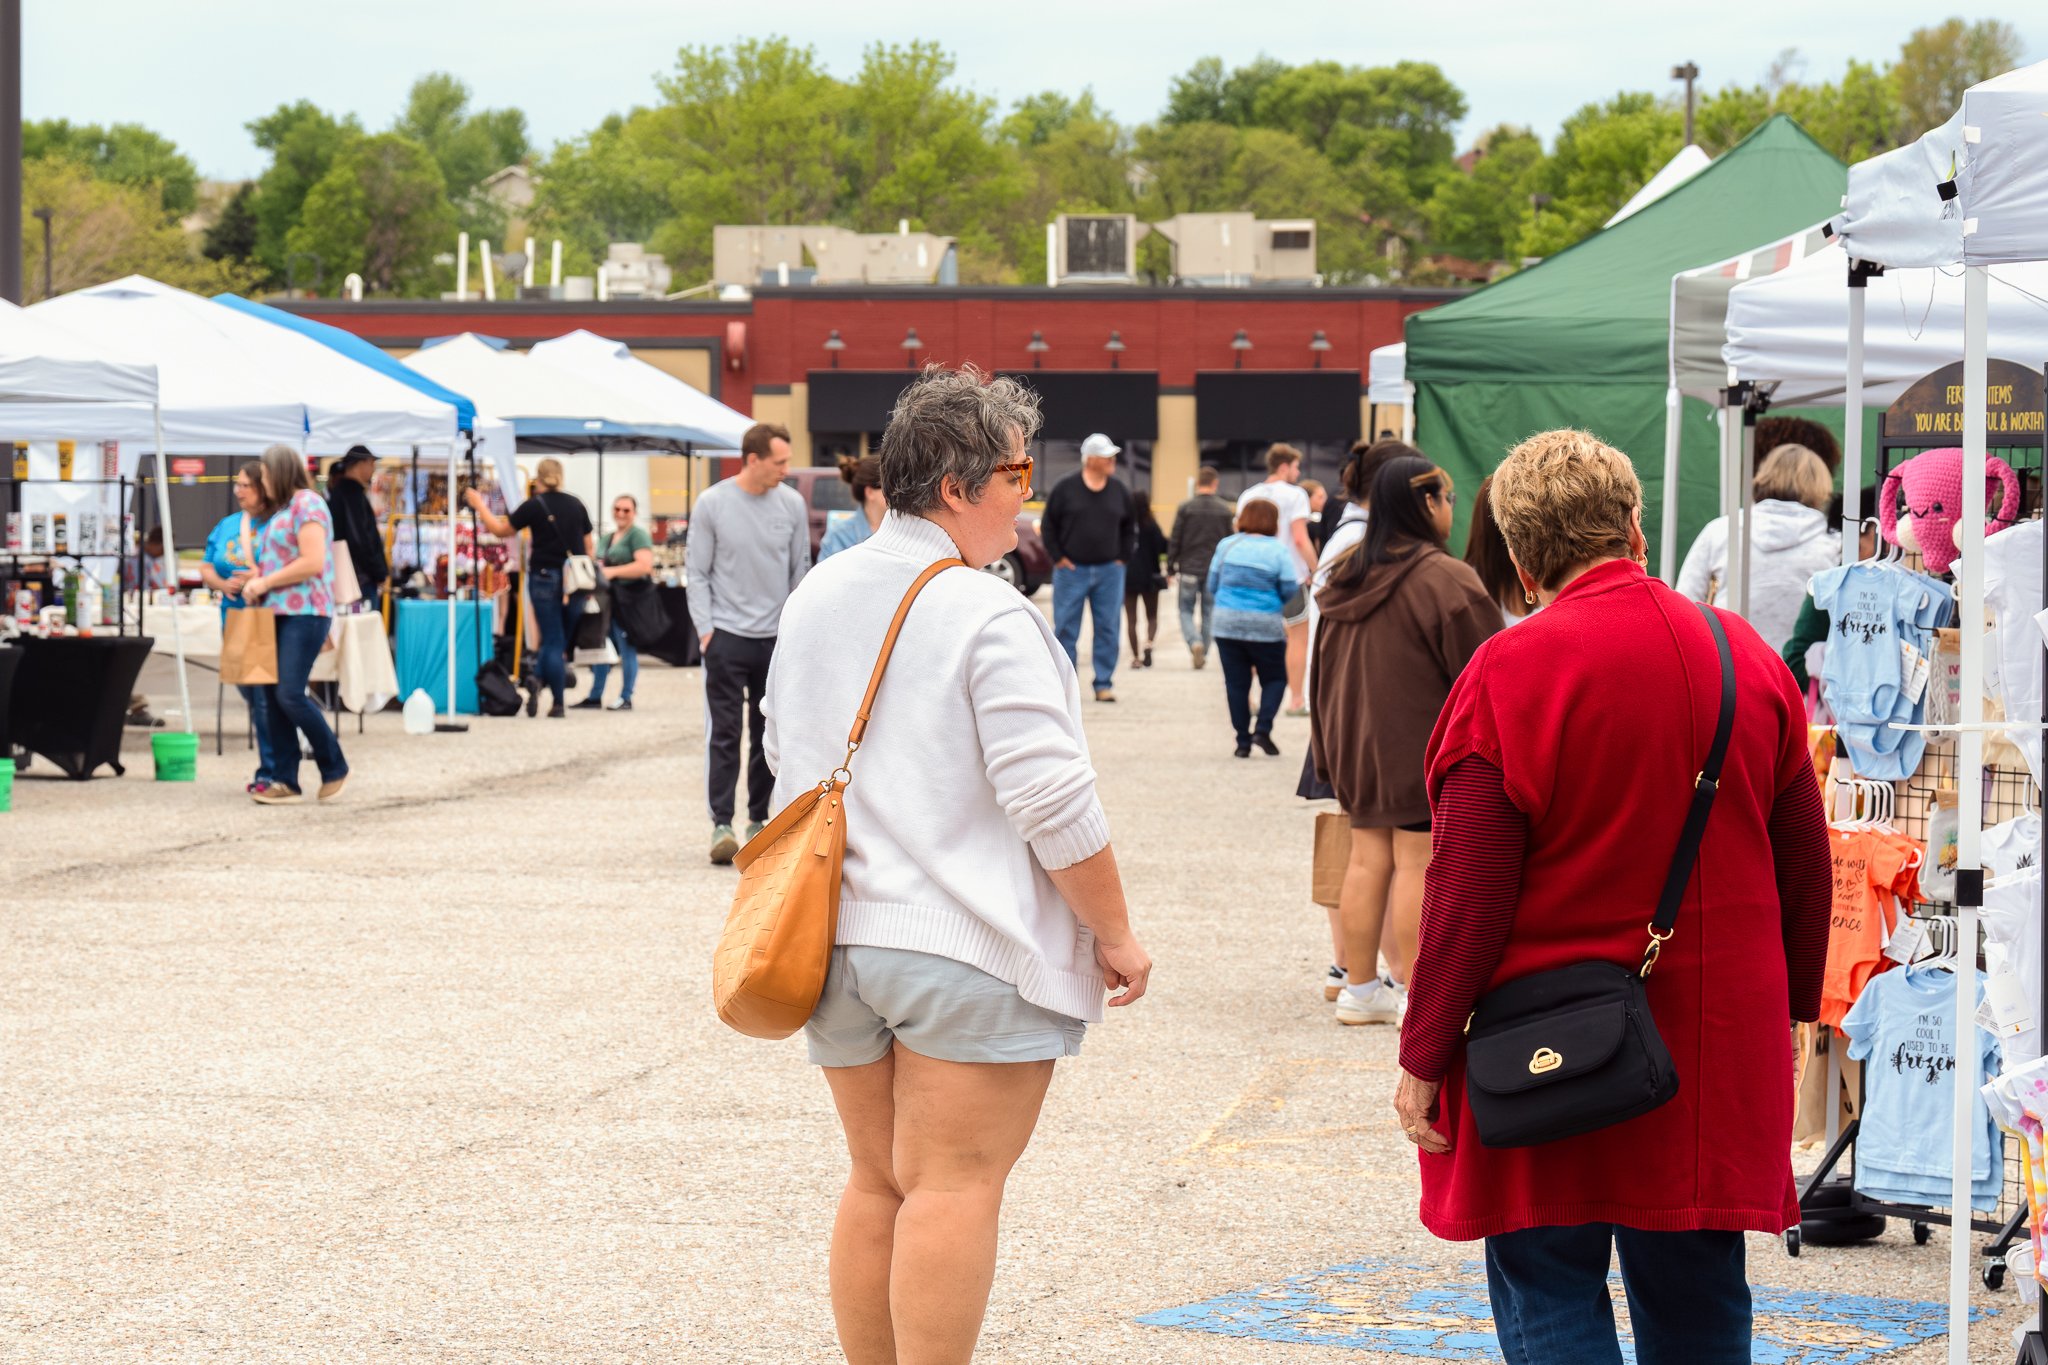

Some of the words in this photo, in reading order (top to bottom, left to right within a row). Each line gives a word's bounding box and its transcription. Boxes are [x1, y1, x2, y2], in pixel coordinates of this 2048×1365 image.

[1987, 384, 2013, 405] ITEMS
[1915, 412, 1932, 432] YOU
[1934, 412, 1952, 432] ARE
[2000, 411, 2007, 432] &
[1919, 1014, 1928, 1025] I'M
[1932, 1016, 1942, 1027] SO
[1916, 1028, 1933, 1039] COOL
[1906, 1040, 1924, 1051] USED
[1928, 1042, 1938, 1053] TO
[1941, 1043, 1949, 1054] BE
[1896, 1042, 1956, 1083] frozen
